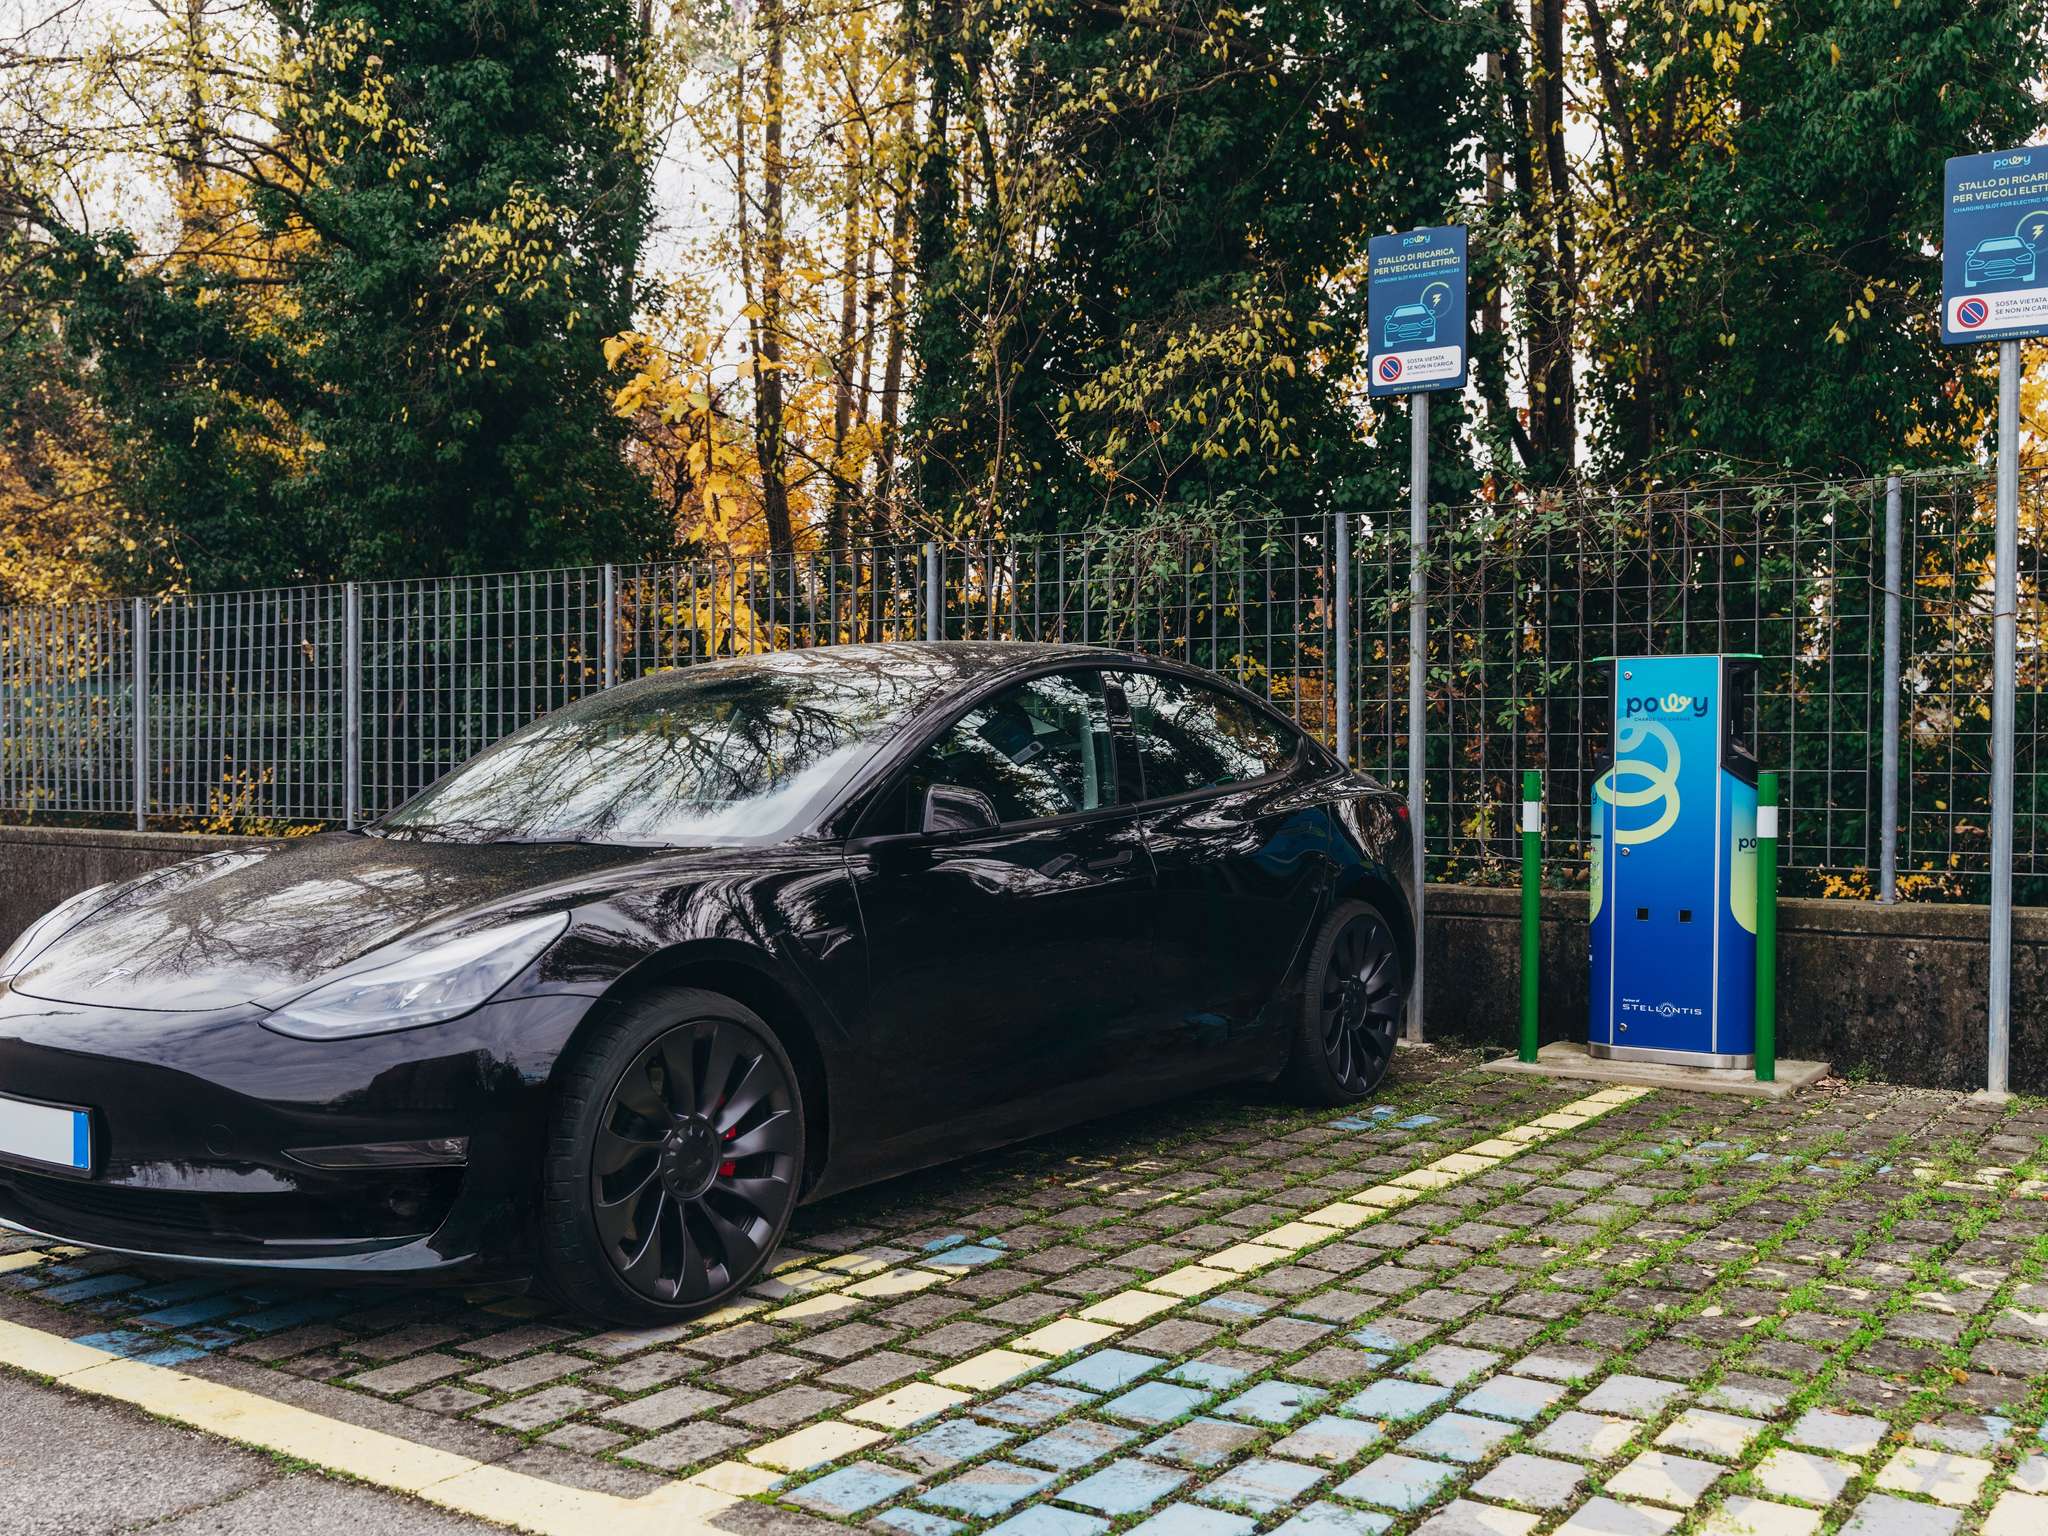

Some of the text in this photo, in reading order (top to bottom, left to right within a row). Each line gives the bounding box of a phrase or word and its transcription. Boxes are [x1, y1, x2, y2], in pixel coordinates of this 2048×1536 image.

[1993, 155, 2031, 169] powy
[1958, 172, 2048, 191] STALLO DI RICARI
[1952, 184, 2048, 203] PER VEICOLI ELETT
[2013, 197, 2040, 206] ELECTRIC
[1377, 248, 1455, 265] STALLO DI RICARICA
[1390, 262, 1421, 273] VEICOLI
[1422, 256, 1460, 268] ELETTRICI
[1627, 693, 1709, 718] powy
[1739, 838, 1757, 852] po
[1622, 1003, 1702, 1016] STELLANTIS
